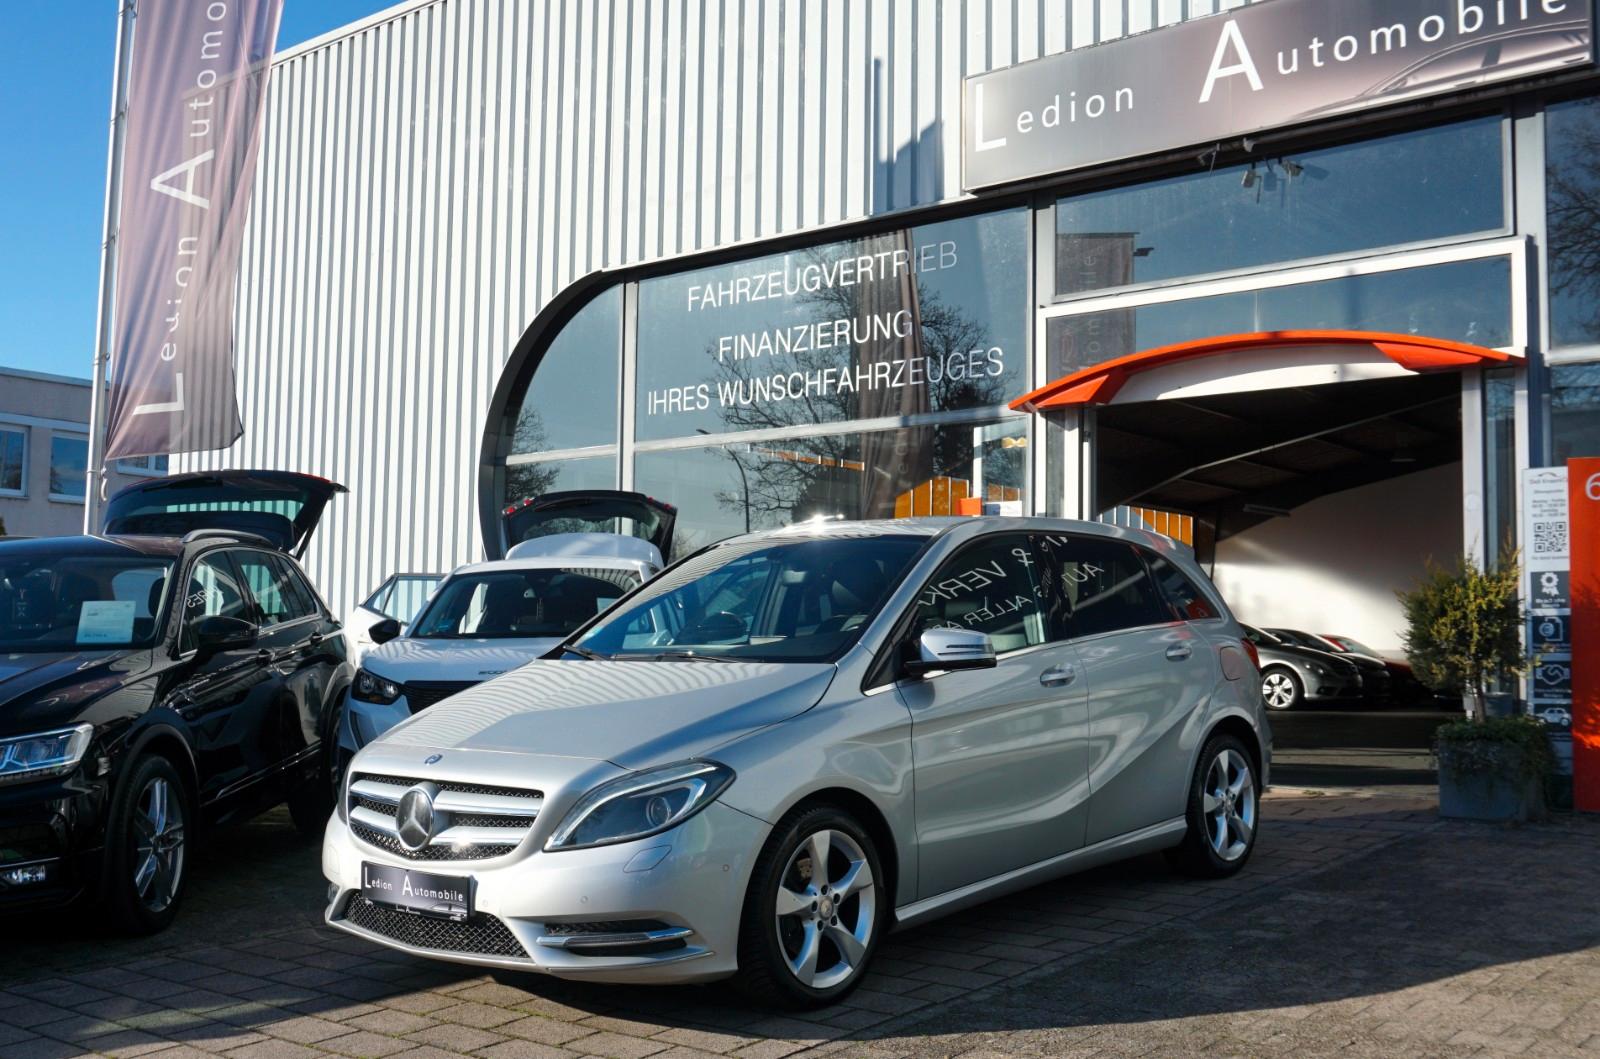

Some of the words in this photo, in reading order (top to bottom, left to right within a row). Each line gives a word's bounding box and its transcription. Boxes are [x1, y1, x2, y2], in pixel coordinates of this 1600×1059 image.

[974, 83, 1134, 152] Ledion
[687, 241, 958, 311] FAHRZEUGVERTRIEB
[718, 309, 912, 362] FINANZIERUNG
[648, 384, 709, 415] IHRES
[718, 347, 1004, 407] WUNSCHFAHRZEUGES
[364, 866, 393, 891] Ledion
[401, 874, 464, 902] Automobile
